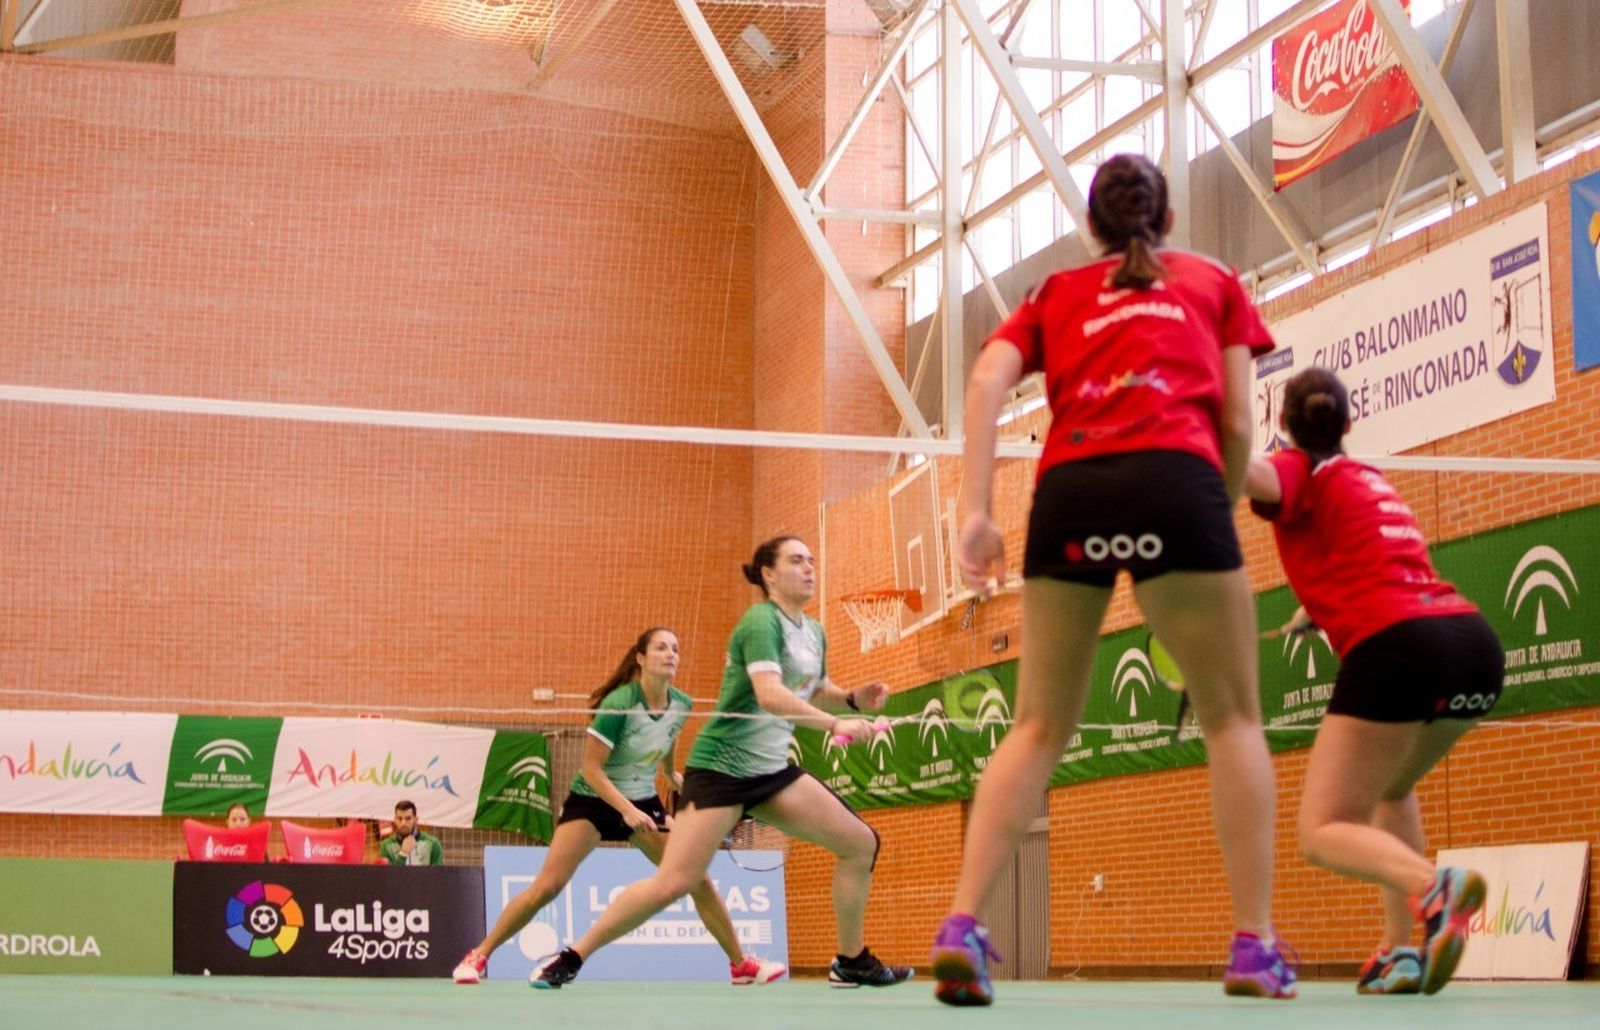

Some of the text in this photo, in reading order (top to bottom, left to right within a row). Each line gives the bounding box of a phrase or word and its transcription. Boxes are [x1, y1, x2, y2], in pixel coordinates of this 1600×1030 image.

[1355, 288, 1467, 363] BALONMANO
[1384, 340, 1488, 410] RINCONADA
[1505, 648, 1526, 668] JUNTA
[1529, 645, 1539, 665] DE
[286, 747, 460, 798] Andalucía
[314, 900, 430, 939] LaLiga
[653, 926, 672, 938] EL
[676, 926, 752, 938] DEPTE
[327, 934, 430, 964] 4Sports
